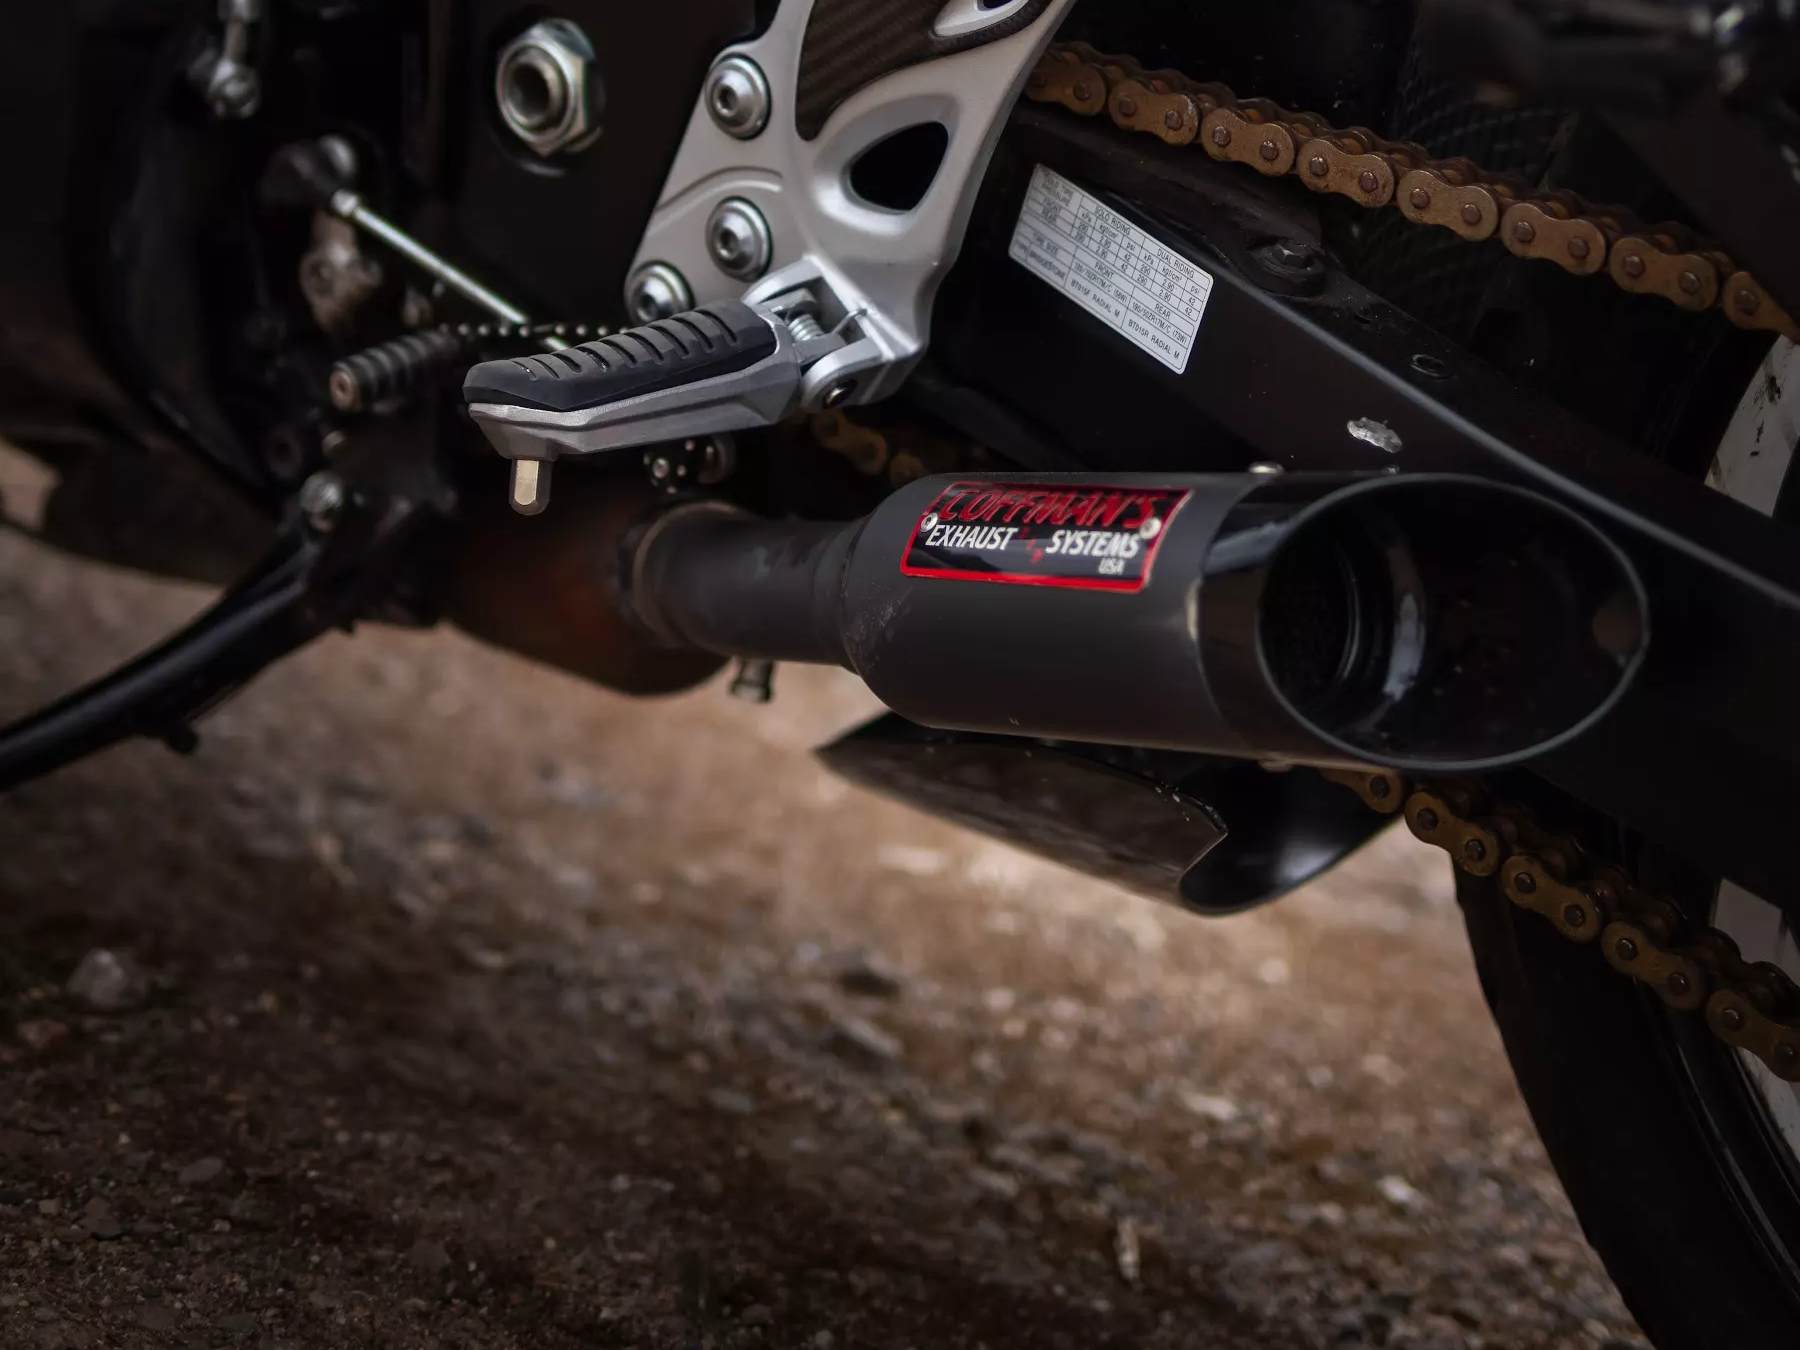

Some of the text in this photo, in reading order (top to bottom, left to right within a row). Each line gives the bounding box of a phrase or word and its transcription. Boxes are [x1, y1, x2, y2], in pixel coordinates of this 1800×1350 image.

[1082, 212, 1091, 223] kPa
[1095, 206, 1131, 235] SOLO RIDING
[1127, 242, 1136, 252] psi
[1124, 253, 1131, 263] 42
[1144, 253, 1154, 265] kPa
[1157, 248, 1195, 279] DUAL RIDING
[1095, 261, 1114, 279] FRONT
[1121, 263, 1128, 273] 42
[1140, 264, 1151, 276] 290
[1137, 274, 1148, 286] 290
[1162, 279, 1175, 292] 2.90
[1158, 289, 1172, 302] 2.90
[1191, 286, 1200, 295] psi
[1092, 294, 1112, 313] RADIAL
[1114, 309, 1120, 318] M
[1188, 296, 1196, 306] 42
[1155, 303, 1171, 319] REAR
[1185, 306, 1193, 317] 42
[1128, 318, 1180, 360] BT015R RADIAL M
[938, 488, 1164, 529] COFFMAN'S
[925, 524, 1140, 559] EXHAUST SYSTEMS
[1097, 557, 1126, 576] USA
